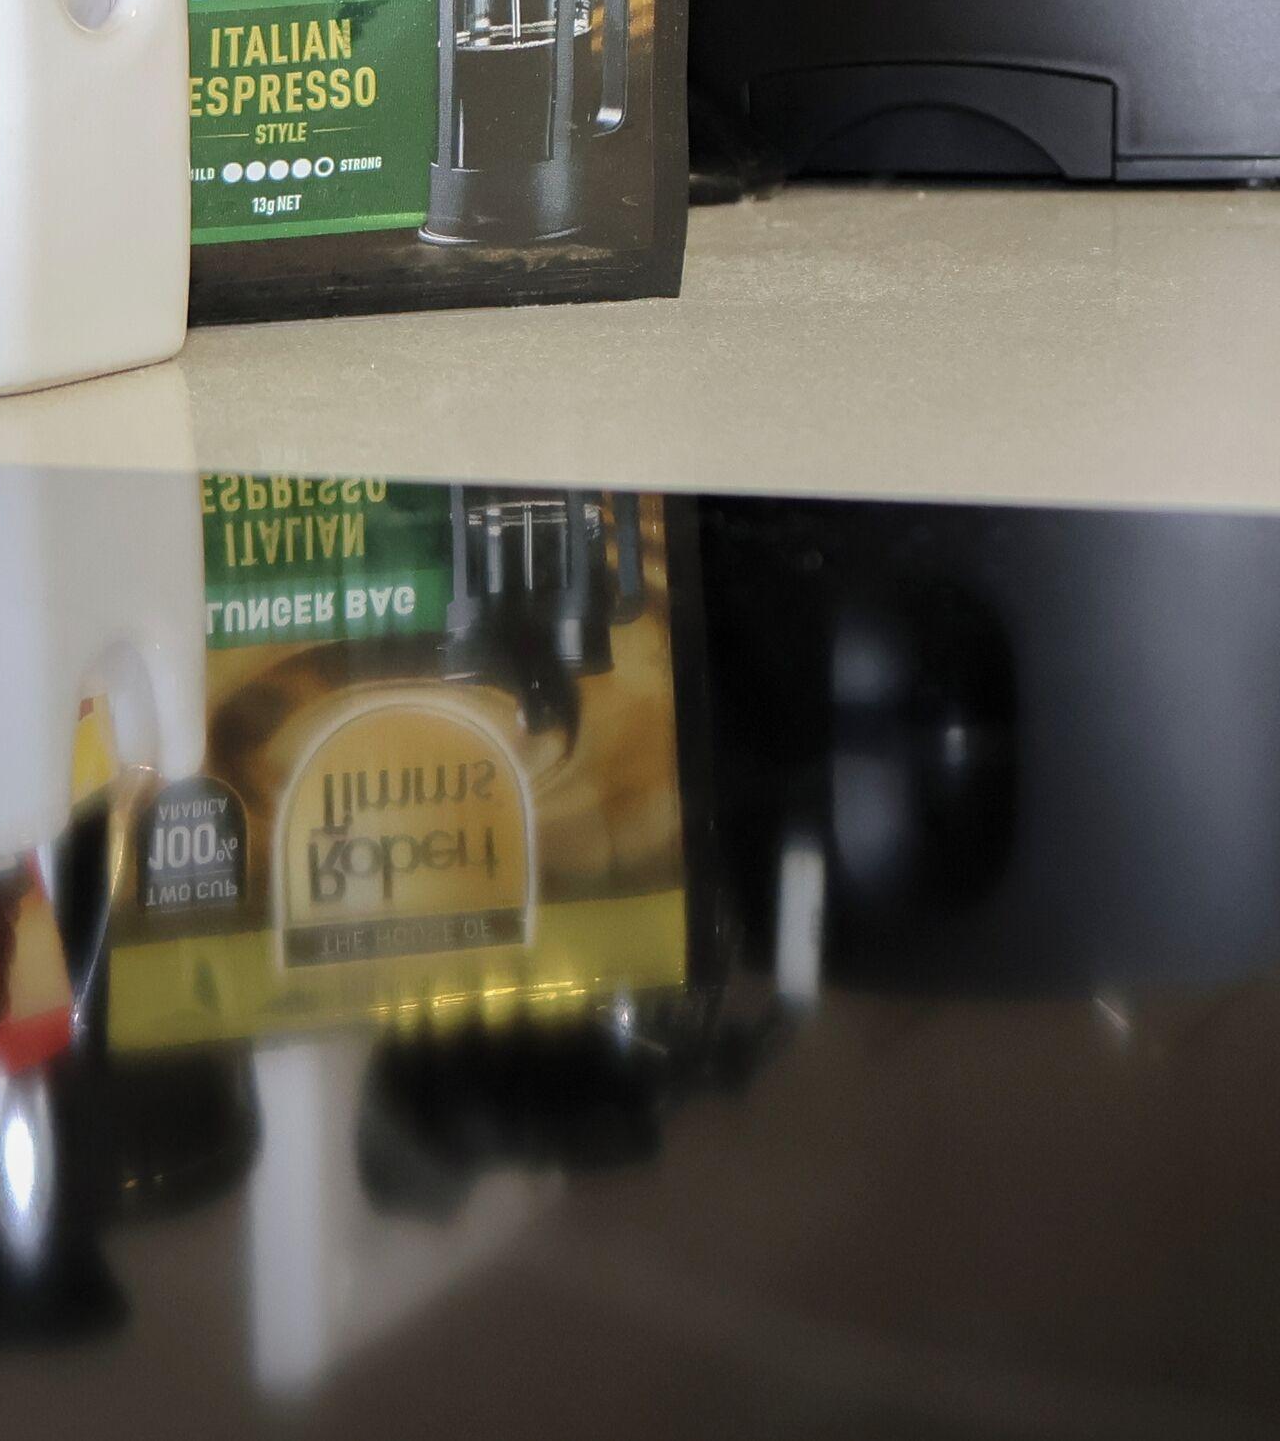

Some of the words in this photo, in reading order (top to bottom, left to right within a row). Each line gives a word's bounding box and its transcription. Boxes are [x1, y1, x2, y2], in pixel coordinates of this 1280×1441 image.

[210, 18, 352, 69] ITALIAN
[189, 66, 377, 117] ESPRESSO
[255, 122, 308, 145] STYLE
[191, 167, 216, 182] ILD
[339, 156, 382, 172] STRONG
[277, 194, 302, 212] NET
